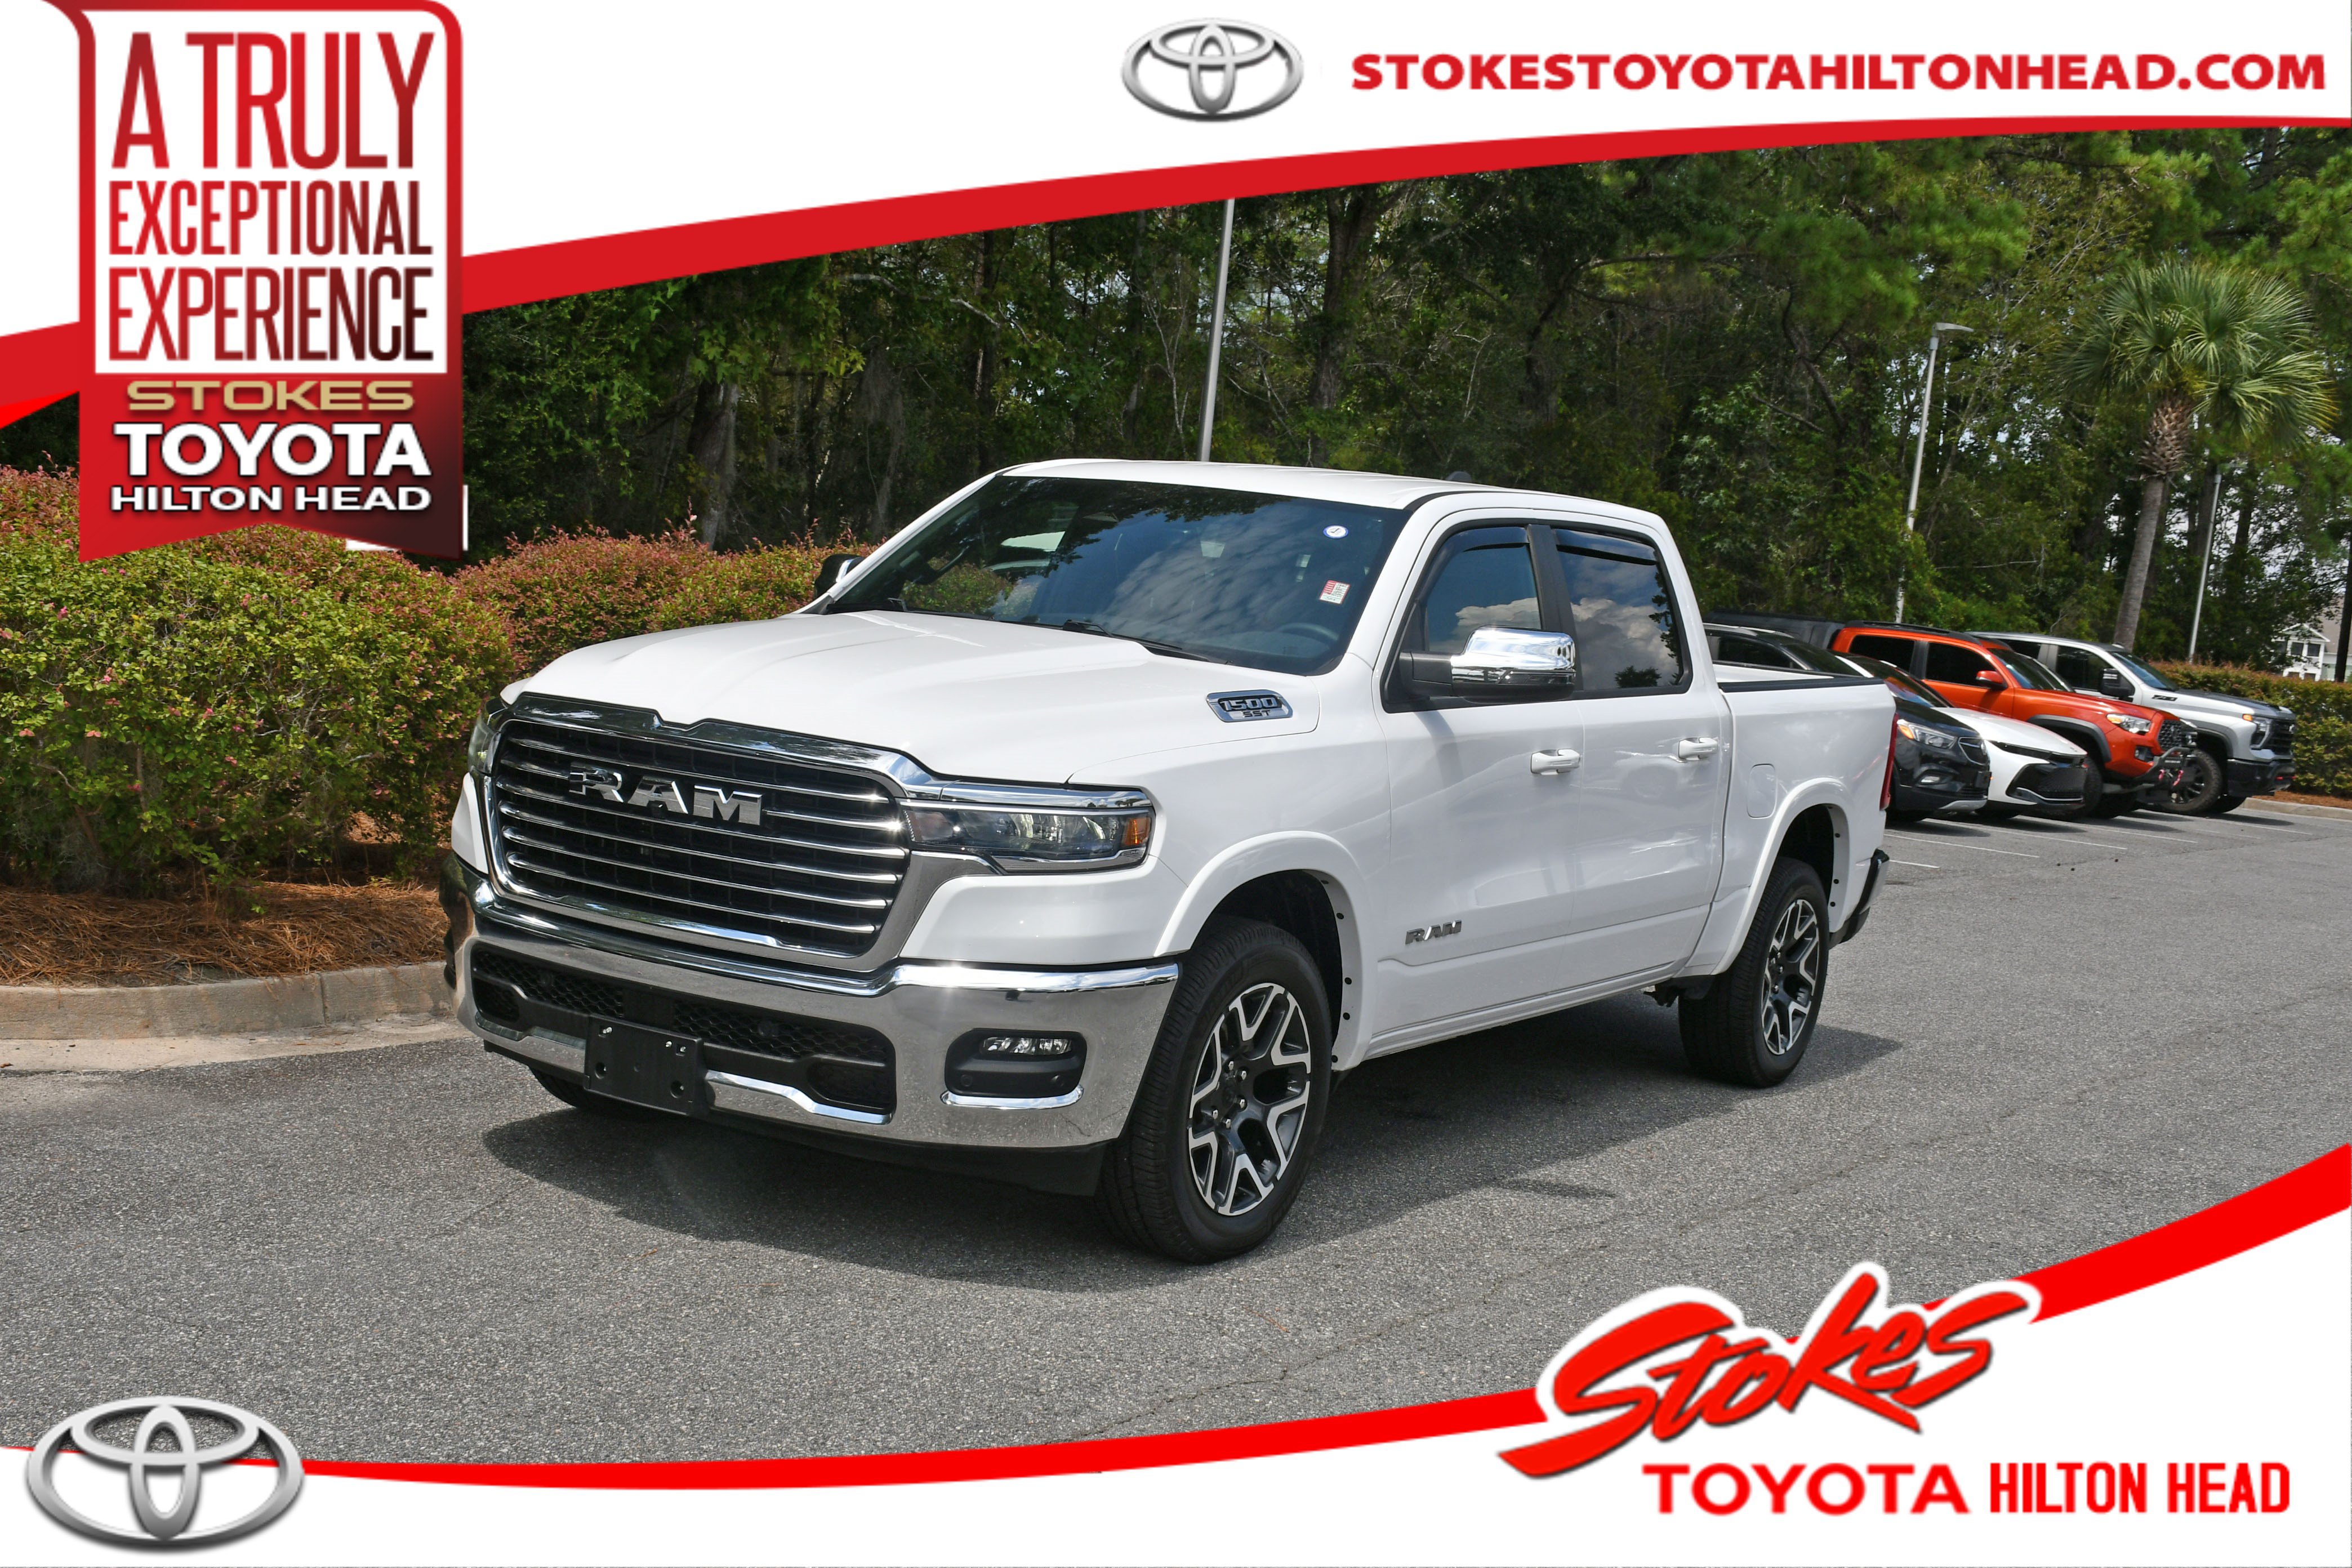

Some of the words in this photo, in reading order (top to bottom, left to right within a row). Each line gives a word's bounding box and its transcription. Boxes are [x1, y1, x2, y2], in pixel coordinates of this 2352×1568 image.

[1219, 697, 1278, 711] 1500
[569, 762, 762, 826] RAM
[1405, 919, 1462, 945] RAM
